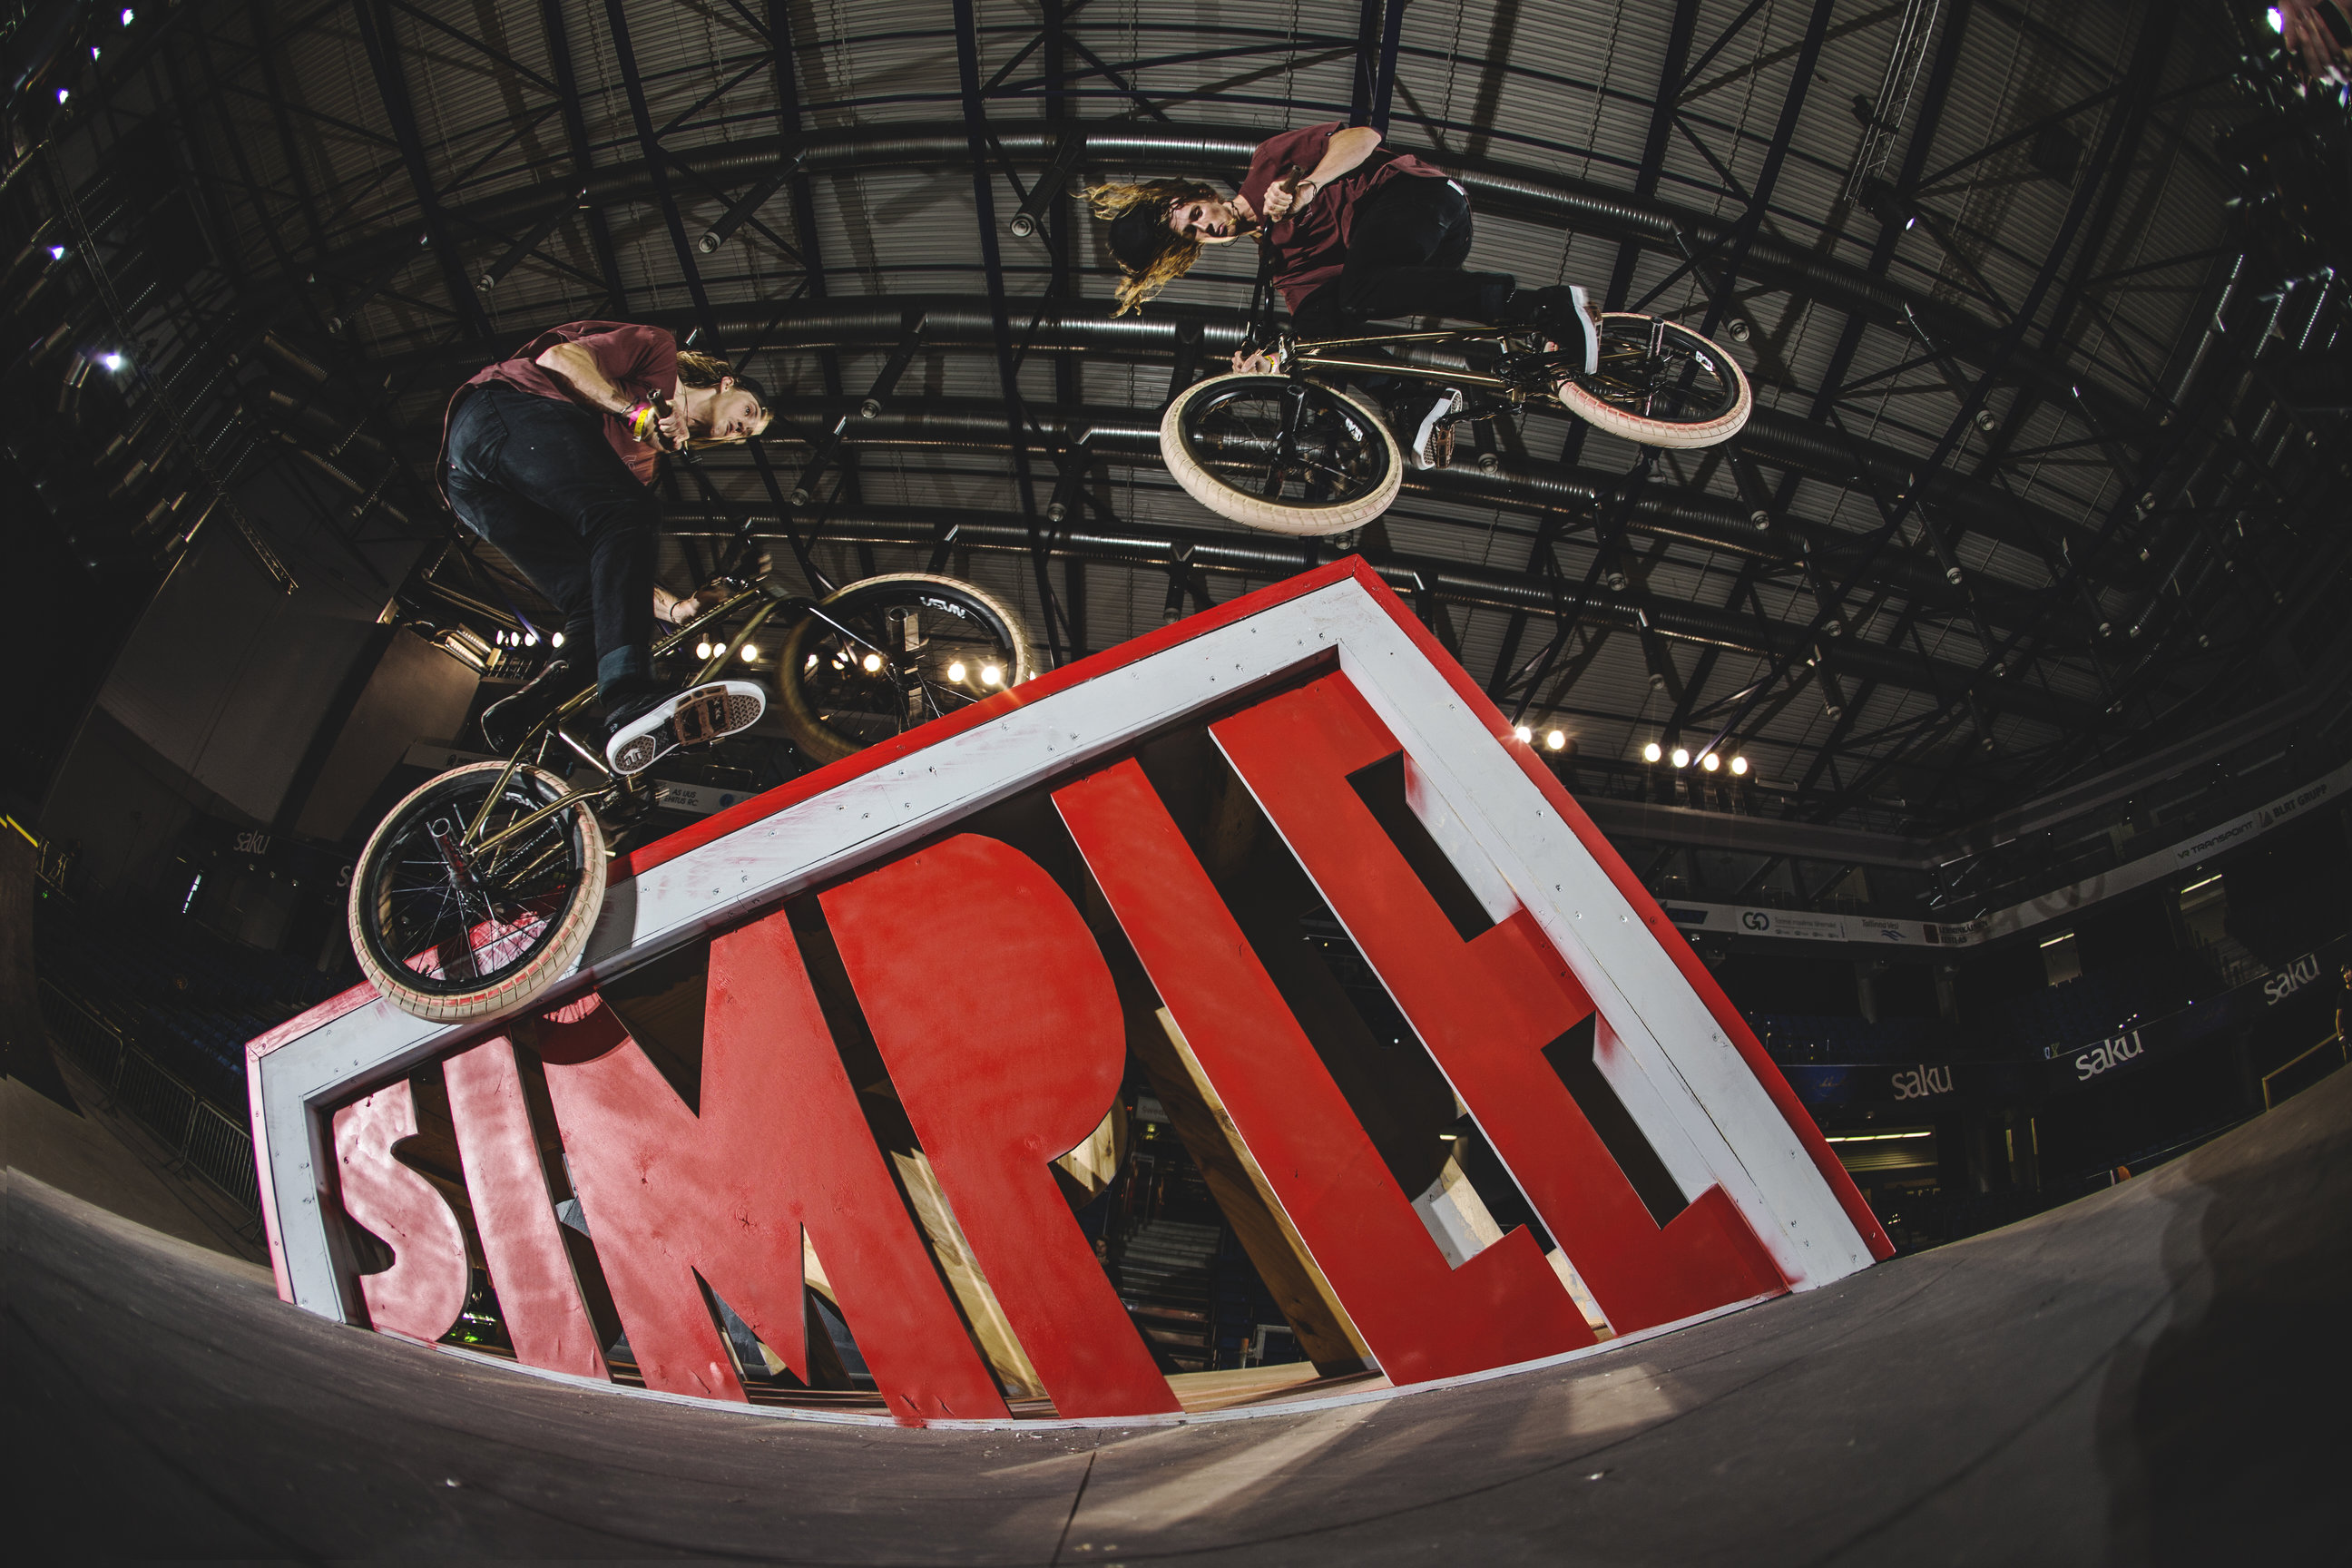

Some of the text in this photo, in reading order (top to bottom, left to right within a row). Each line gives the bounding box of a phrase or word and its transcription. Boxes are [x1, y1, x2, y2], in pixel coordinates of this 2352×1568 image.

[672, 789, 681, 797] AS
[2272, 784, 2328, 818] BLRT GRUPP
[232, 829, 270, 855] saku
[2177, 821, 2253, 859] VR TRANSPOINT
[2262, 953, 2321, 1006] saku
[333, 670, 1788, 1422] SIMPLE
[2074, 1029, 2144, 1082] saku
[1891, 1063, 1955, 1101] saku
